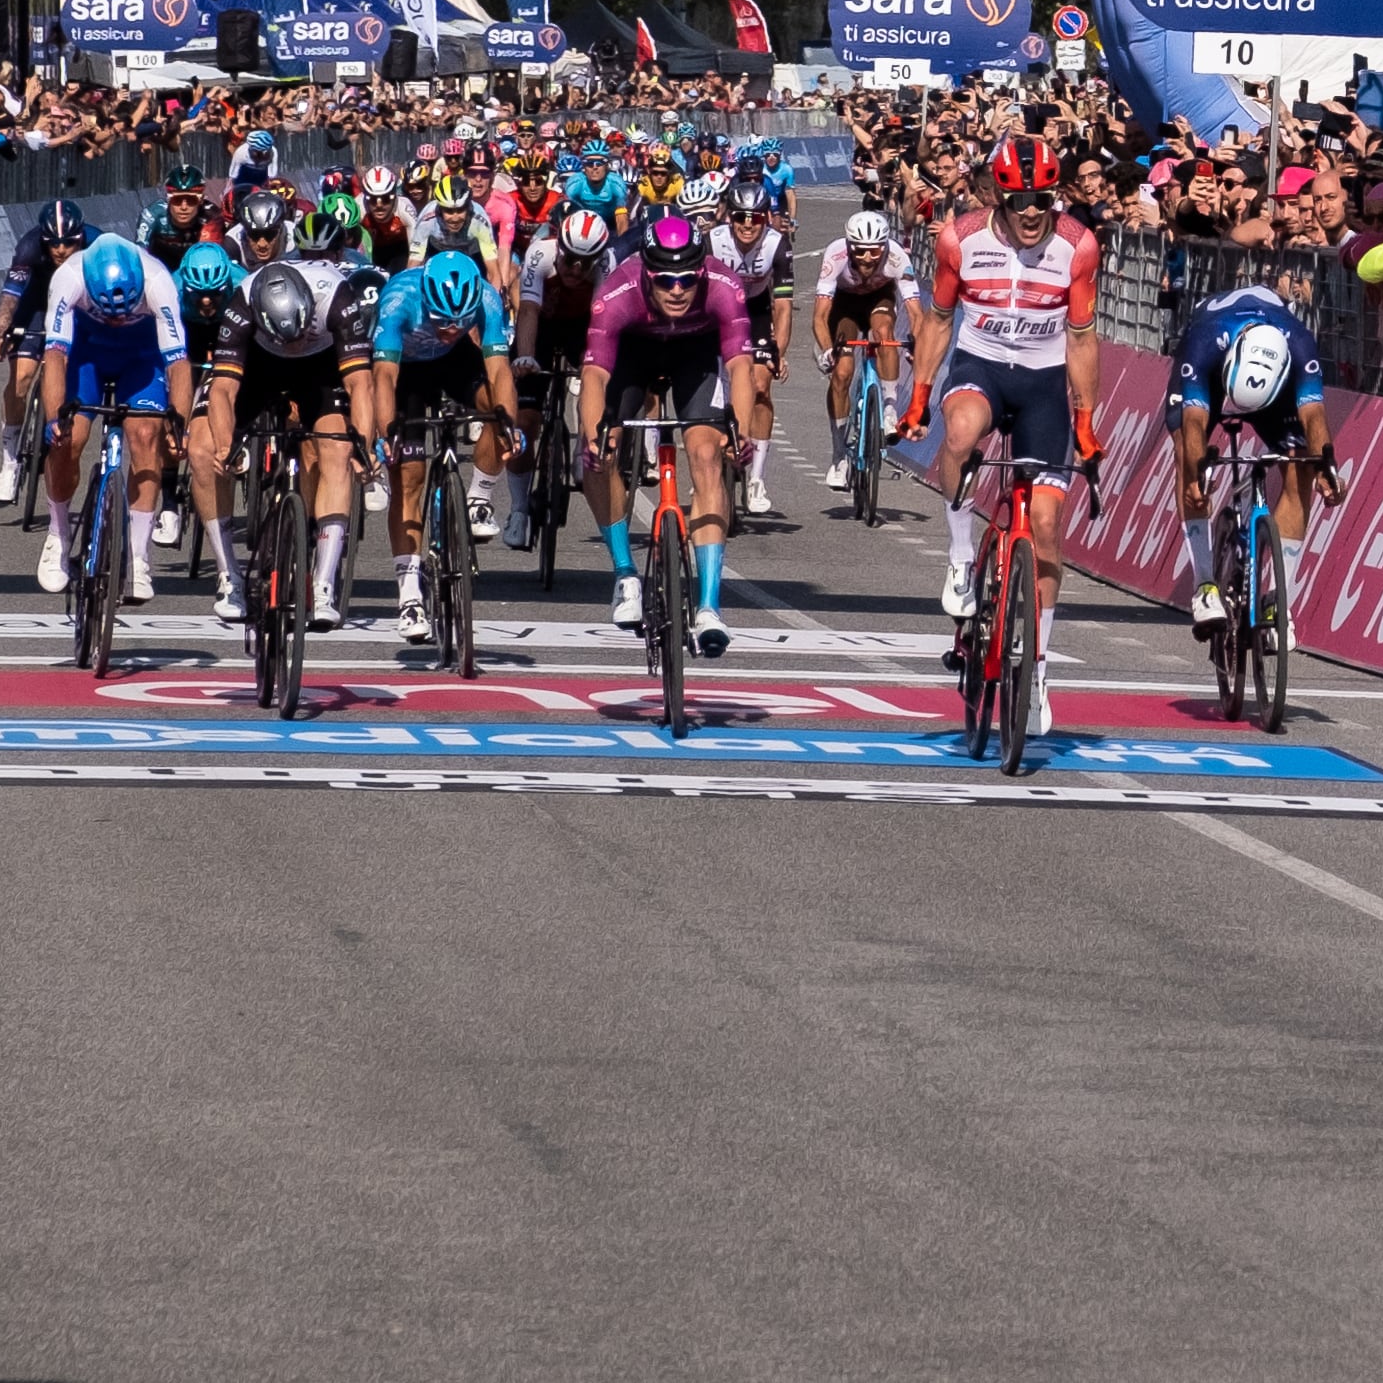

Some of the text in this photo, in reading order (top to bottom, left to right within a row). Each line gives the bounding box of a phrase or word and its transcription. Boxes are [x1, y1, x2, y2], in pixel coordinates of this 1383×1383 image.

[71, 27, 144, 41] ti assicura
[292, 21, 350, 41] sara
[487, 29, 535, 46] sara
[843, 23, 951, 46] ti assicura
[135, 55, 158, 66] 100
[1220, 40, 1255, 66] 10
[890, 64, 912, 80] 50
[93, 680, 945, 720] enel
